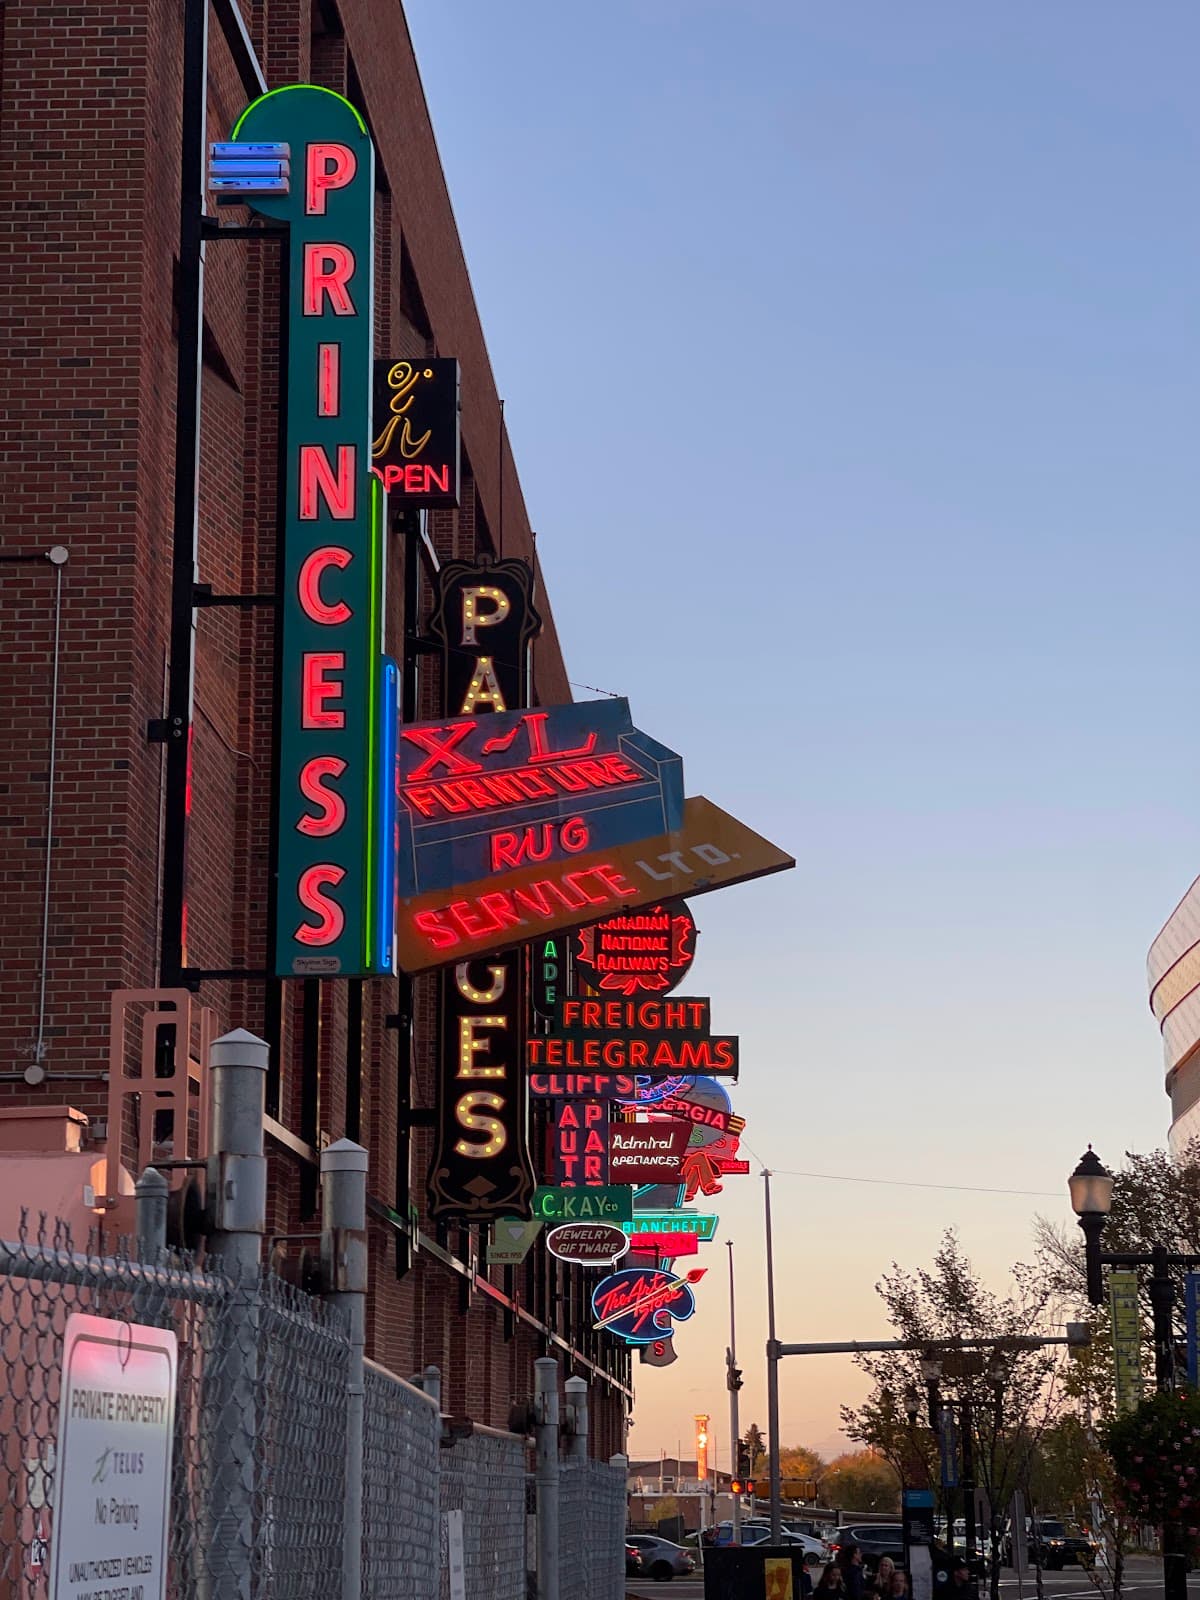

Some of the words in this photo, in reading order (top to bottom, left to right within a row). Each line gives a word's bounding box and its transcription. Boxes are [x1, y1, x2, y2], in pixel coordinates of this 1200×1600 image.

[294, 142, 357, 946] PRINCESS
[403, 752, 645, 818] FURNITURE
[490, 816, 589, 873] RUG
[414, 864, 639, 950] SERVICE
[635, 842, 741, 882] LTD.
[601, 935, 669, 951] NATIONAL
[597, 954, 669, 971] RAILWAYS
[563, 1002, 705, 1030] FREIGHT
[527, 1039, 735, 1069] TELEGRAMS
[558, 1104, 580, 1188] AUT
[584, 1104, 606, 1187] PAR
[611, 1132, 674, 1150] Admiral
[611, 1155, 681, 1168] APPLIANCES
[563, 1195, 607, 1217] KAY
[556, 1229, 612, 1240] JEWELRY
[622, 1220, 709, 1234] BLANCHETT
[558, 1242, 619, 1254] GIFTWARE
[595, 1280, 631, 1320] The
[71, 1388, 114, 1421] PRIVATE
[115, 1392, 167, 1424] PROPERTY
[113, 1451, 144, 1475] TELUS
[94, 1498, 107, 1525] No
[109, 1500, 139, 1530] Parking
